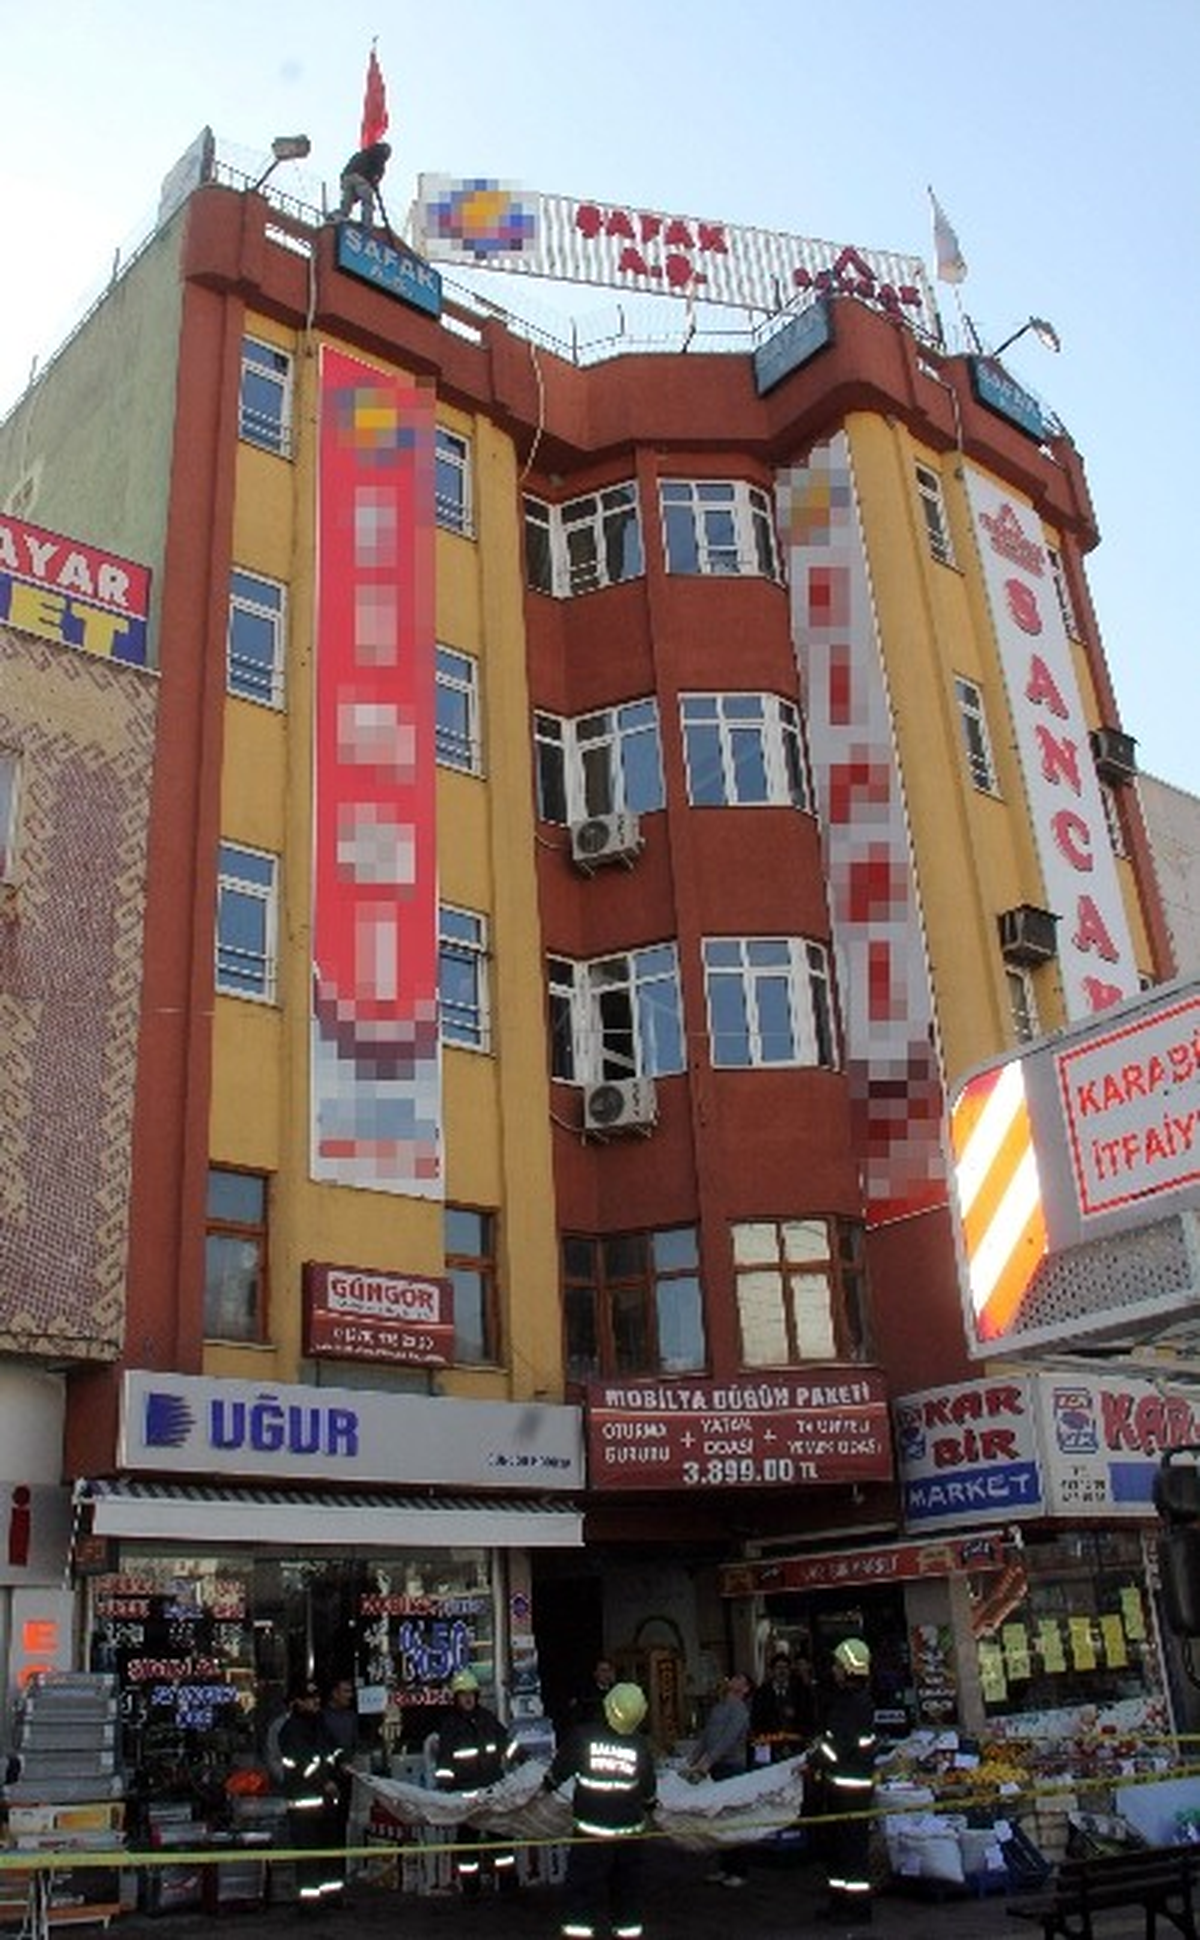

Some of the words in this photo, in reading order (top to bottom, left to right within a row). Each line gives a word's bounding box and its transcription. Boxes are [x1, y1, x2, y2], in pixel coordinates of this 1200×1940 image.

[1076, 1026, 1200, 1117] KARAB
[1091, 1110, 1200, 1181] İTFAİY
[331, 1276, 434, 1313] GÜNGÖR
[605, 1386, 708, 1410] MOBİLYA
[796, 1381, 870, 1406] PAKETİ
[210, 1393, 359, 1458] UĞUR
[682, 1458, 795, 1485] 3.899.00
[909, 1473, 1031, 1509] MARKET
